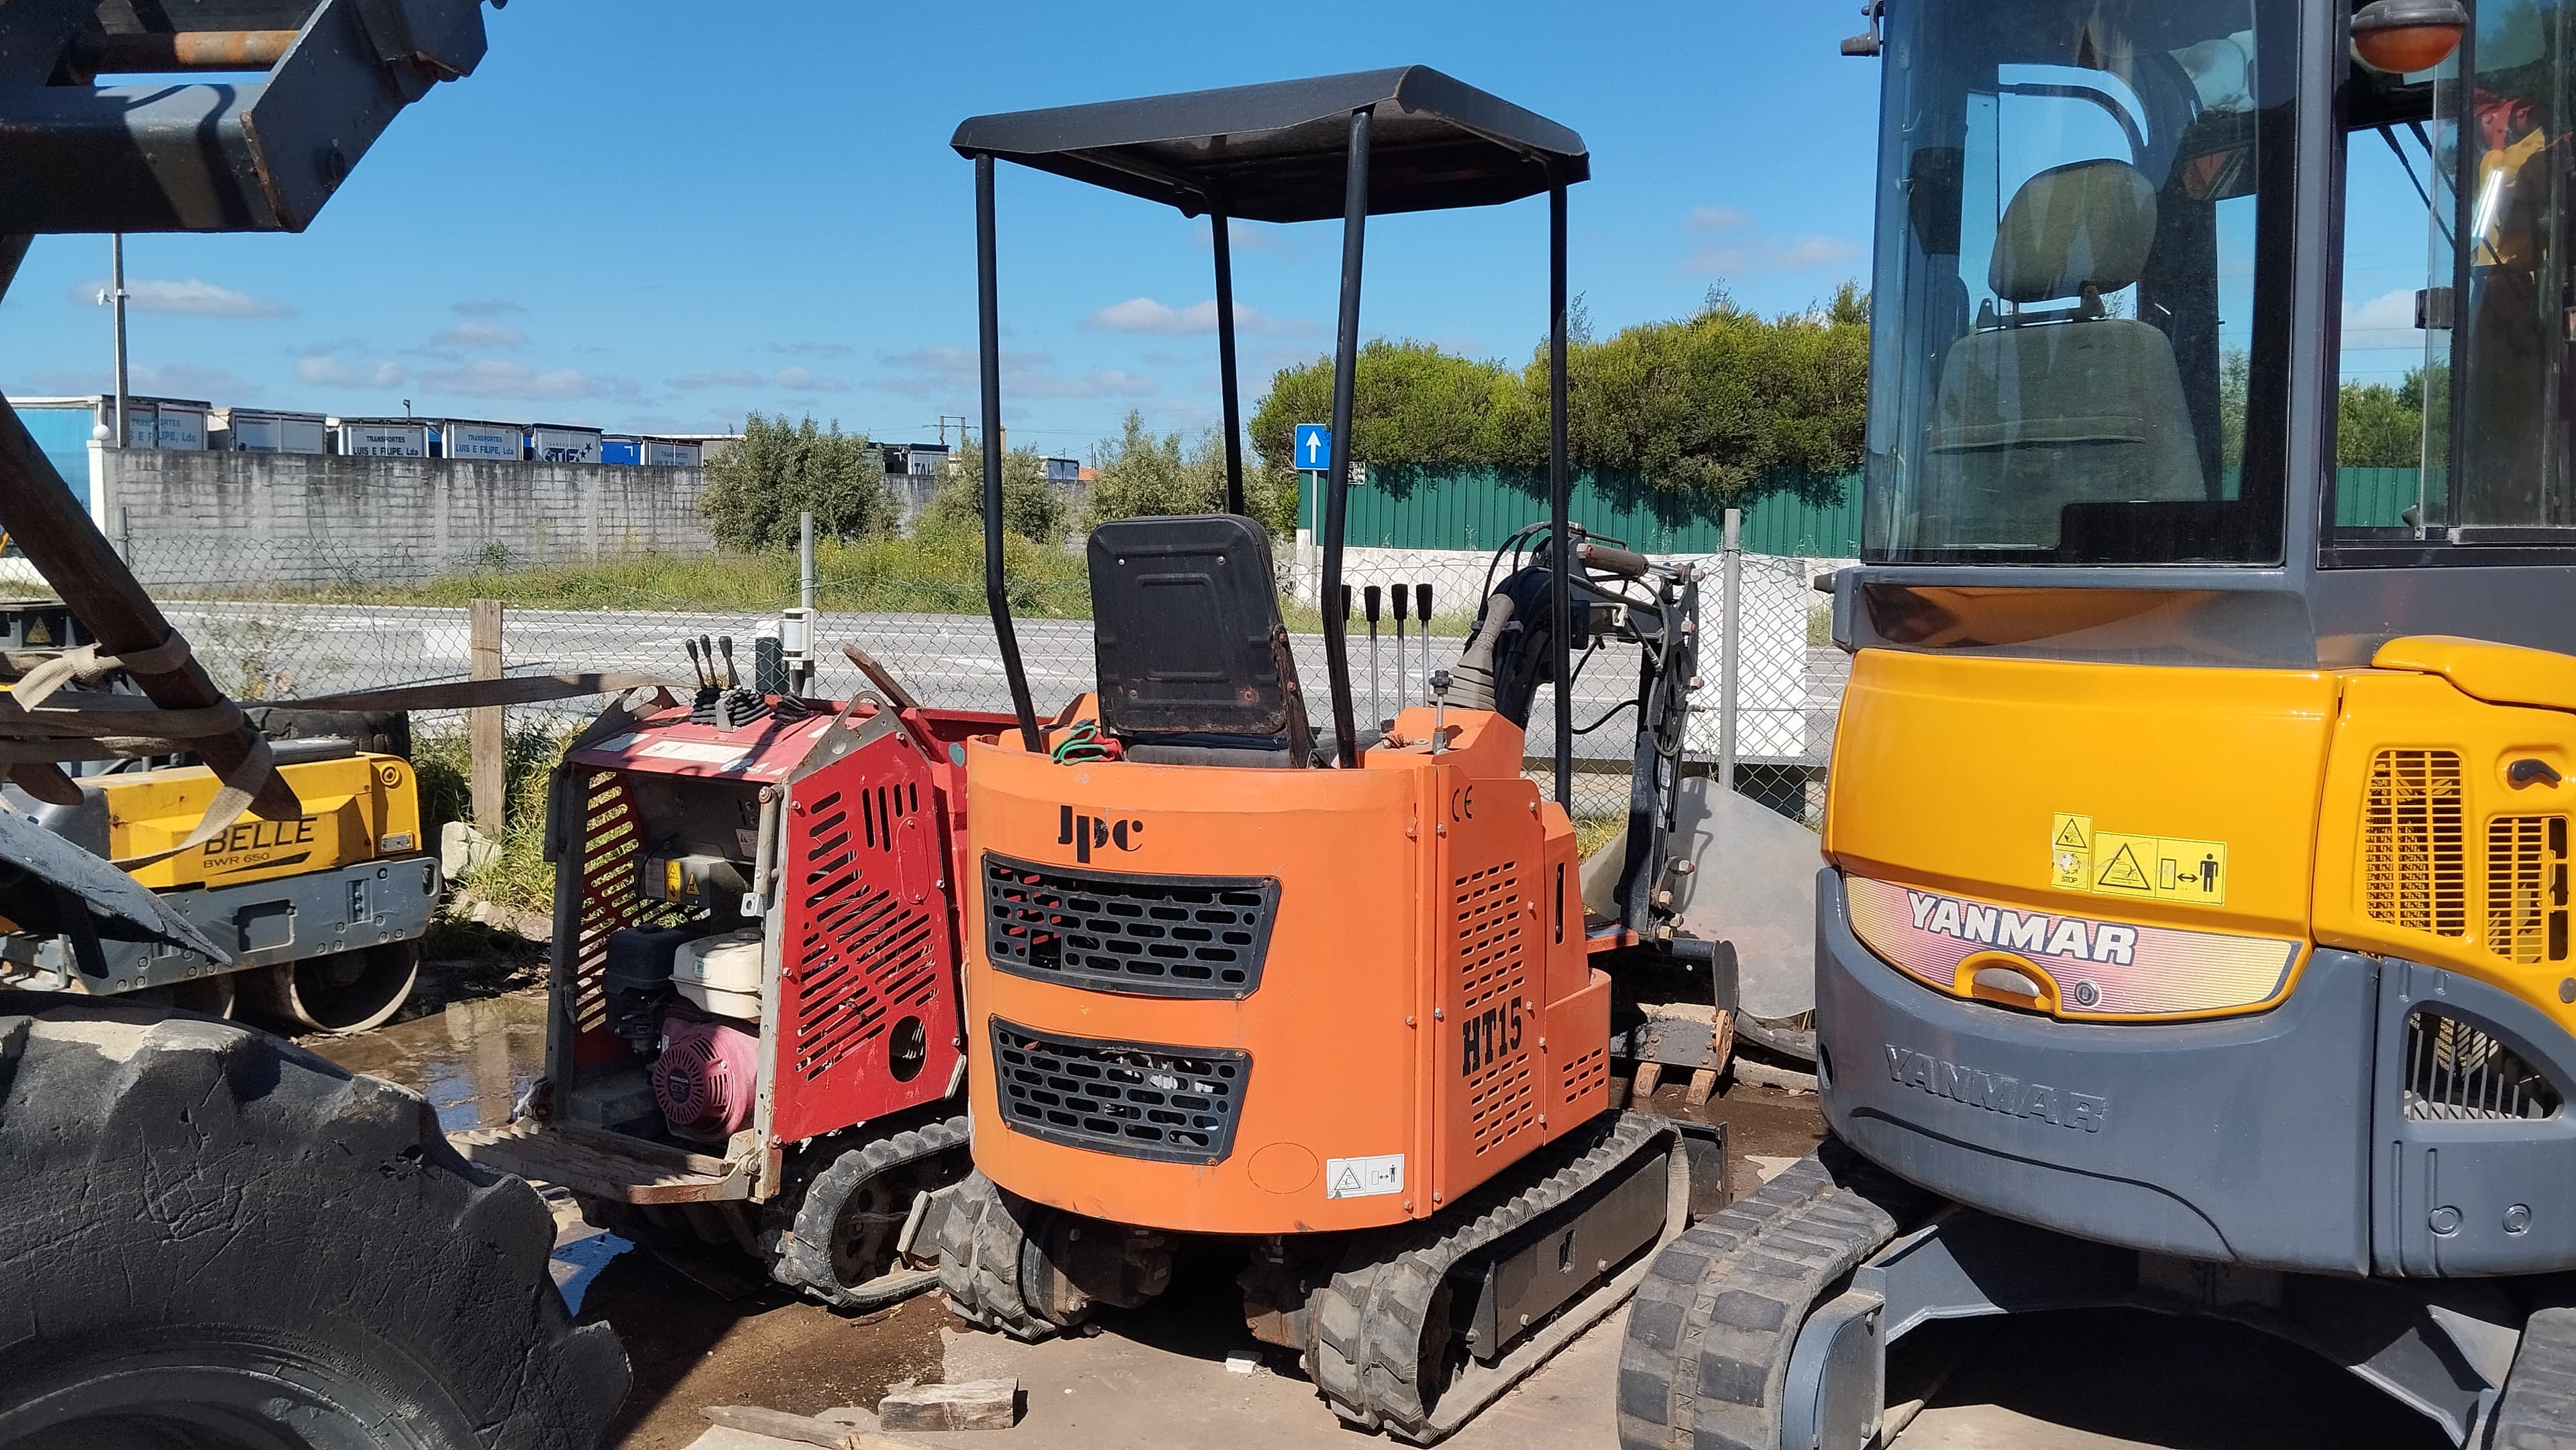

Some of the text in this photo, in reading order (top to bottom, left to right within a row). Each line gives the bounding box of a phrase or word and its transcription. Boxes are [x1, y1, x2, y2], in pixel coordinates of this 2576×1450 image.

[354, 447, 369, 455] LUIS
[456, 444, 470, 452] LUIS
[503, 447, 515, 456] Lda
[468, 435, 503, 443] TRANSPORTES
[1452, 785, 1472, 823] CE
[204, 817, 317, 856] BELLE
[204, 852, 270, 868] BWR 650
[1907, 890, 2137, 967] YANMAR
[1462, 996, 1521, 1078] HT15
[669, 1075, 689, 1084] HONDA
[1884, 1043, 2109, 1133] YANMAR
